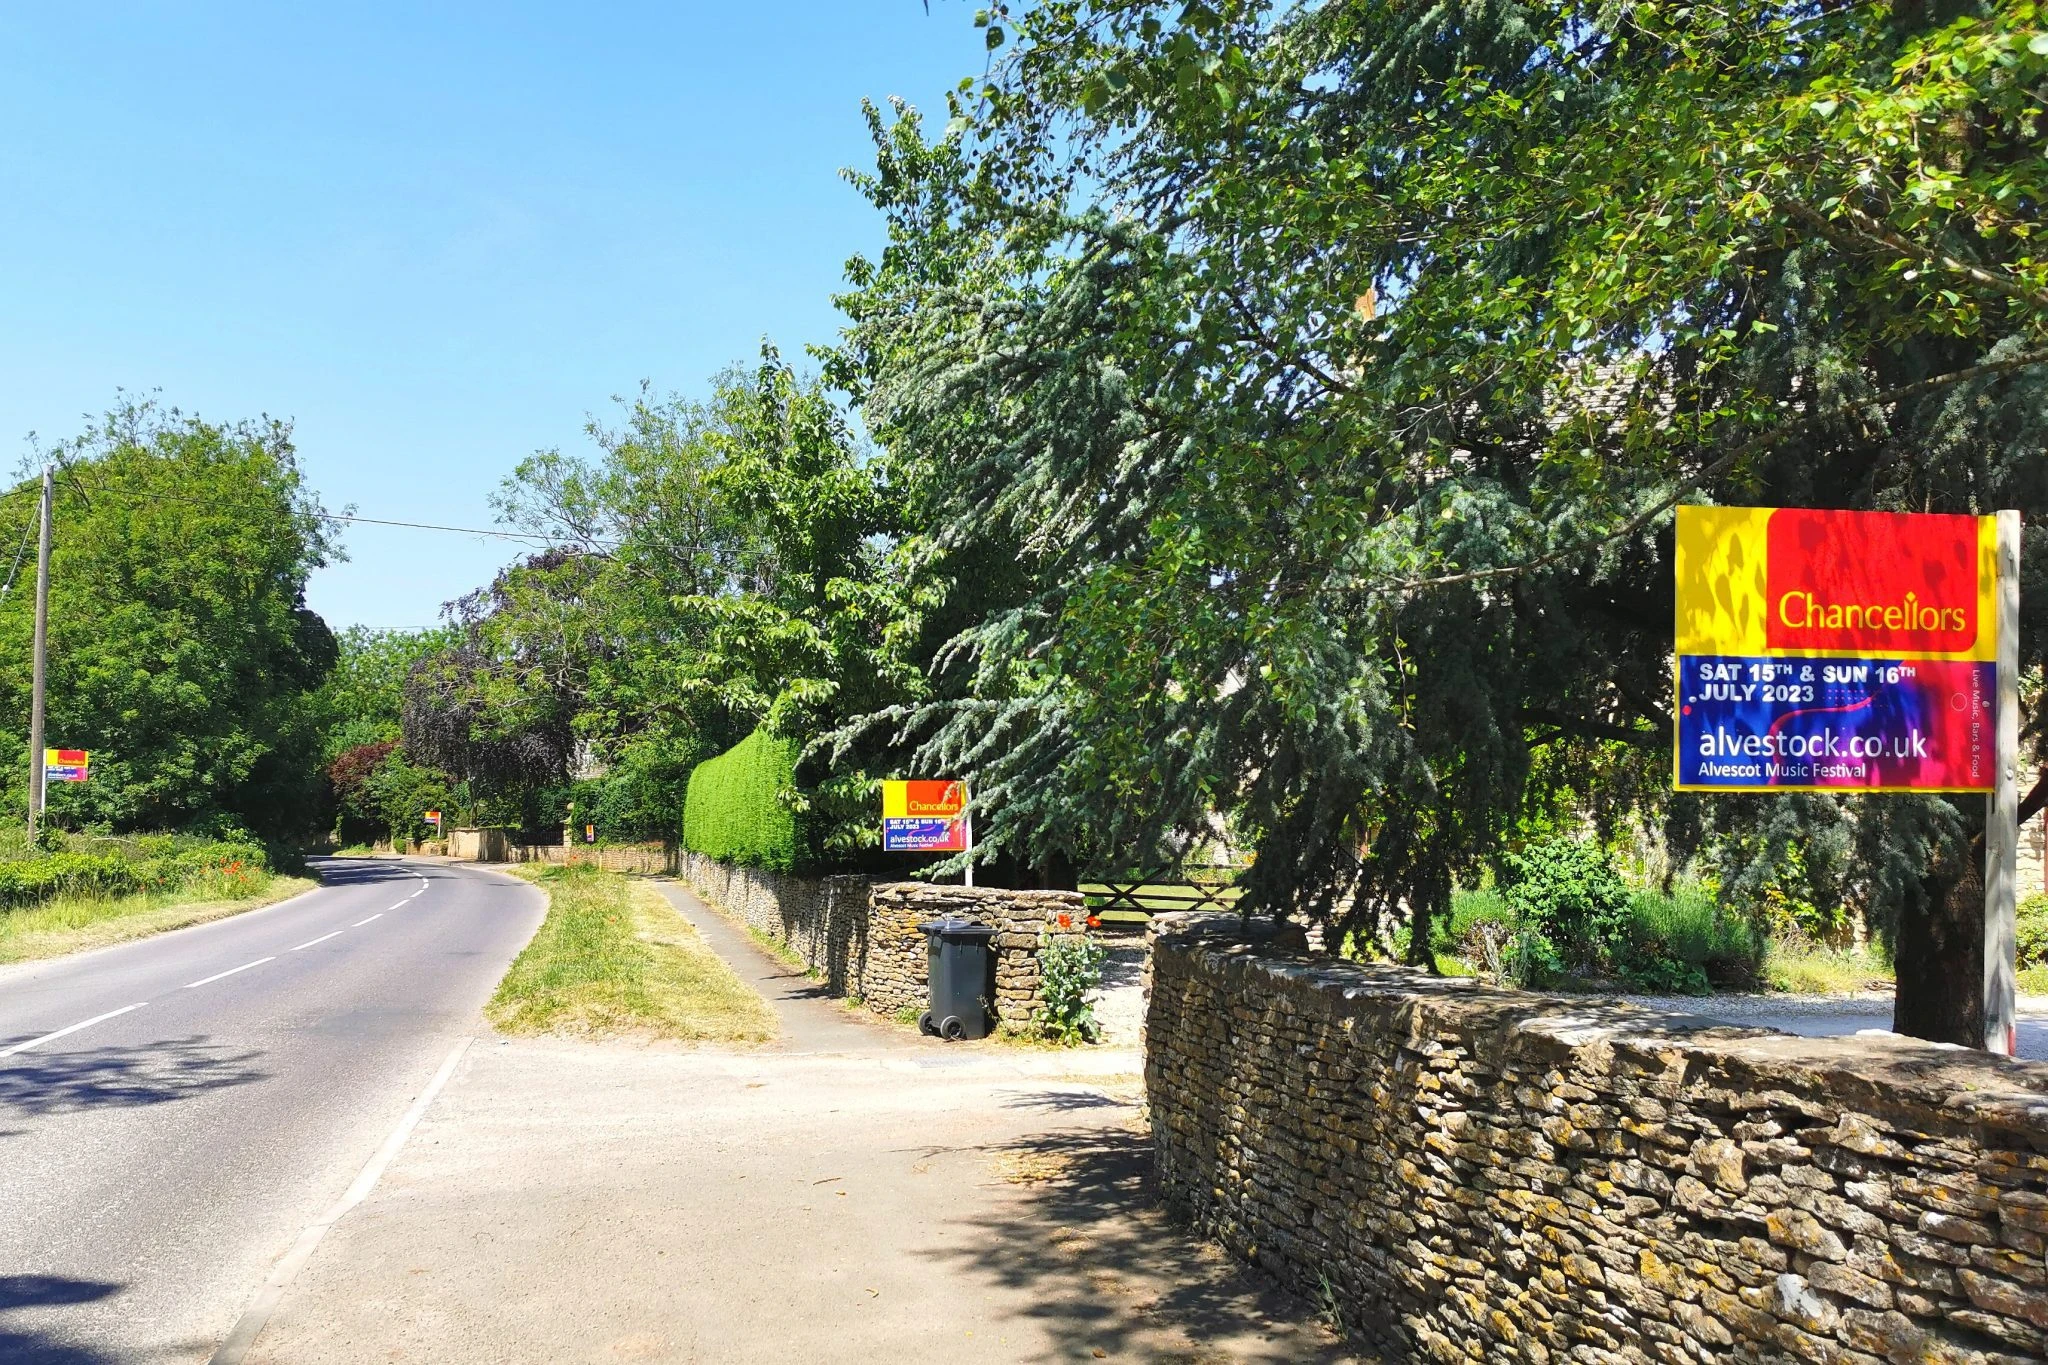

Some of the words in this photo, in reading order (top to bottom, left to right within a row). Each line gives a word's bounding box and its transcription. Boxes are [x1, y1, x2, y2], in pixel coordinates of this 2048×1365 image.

[1779, 591, 1966, 632] Chancellors
[1700, 664, 1742, 682] SAT
[1750, 664, 1793, 682] 15TH
[1800, 667, 1815, 682] &
[1823, 666, 1867, 683] SUN
[1875, 666, 1916, 684] 16TH
[1972, 669, 1980, 688] Live
[1699, 685, 1753, 702] JULY
[1762, 685, 1815, 702] 2023
[1971, 690, 1980, 720] Music,
[1699, 726, 1927, 758] alvestock.co.uk
[1971, 722, 1980, 742] Bars
[1971, 744, 1980, 752] &
[1699, 762, 1761, 778] Alvescot
[1765, 763, 1808, 778] Music
[1813, 763, 1866, 778] Festival
[1971, 755, 1980, 778] Food
[909, 800, 959, 811] Chancellors
